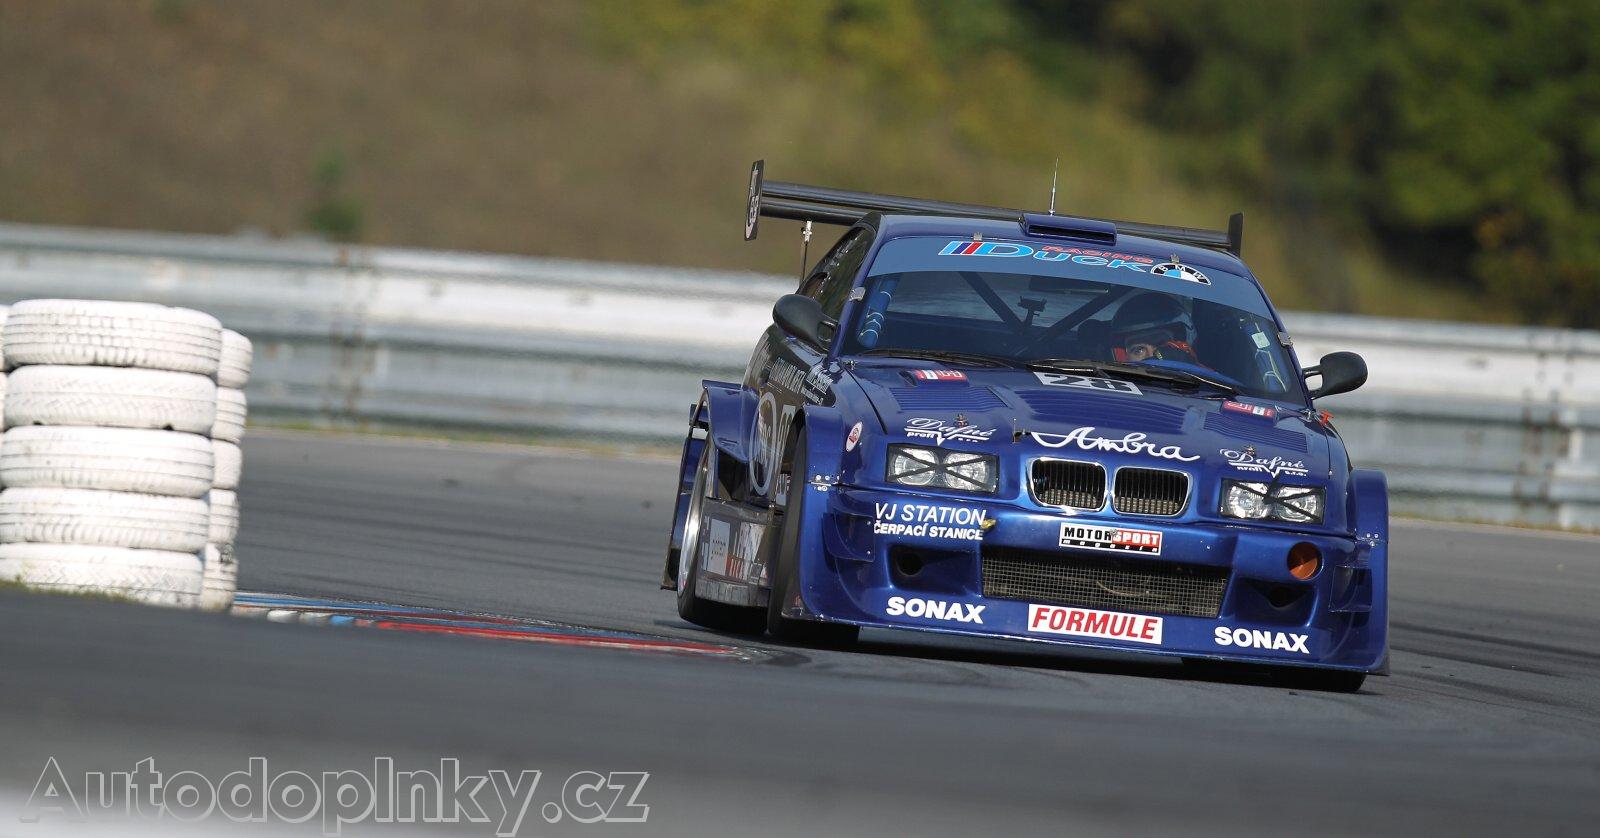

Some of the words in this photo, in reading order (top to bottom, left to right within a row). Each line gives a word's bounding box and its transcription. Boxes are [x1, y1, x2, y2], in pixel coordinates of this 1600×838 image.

[1031, 426, 1201, 462] Ambra
[875, 502, 898, 520] VJ
[900, 504, 987, 526] STATION
[873, 520, 928, 537] ČERPACÍ
[928, 526, 984, 541] STANICE
[885, 596, 986, 624] SONAX
[1031, 606, 1158, 640] FORMULE
[1213, 626, 1310, 654] SONAX
